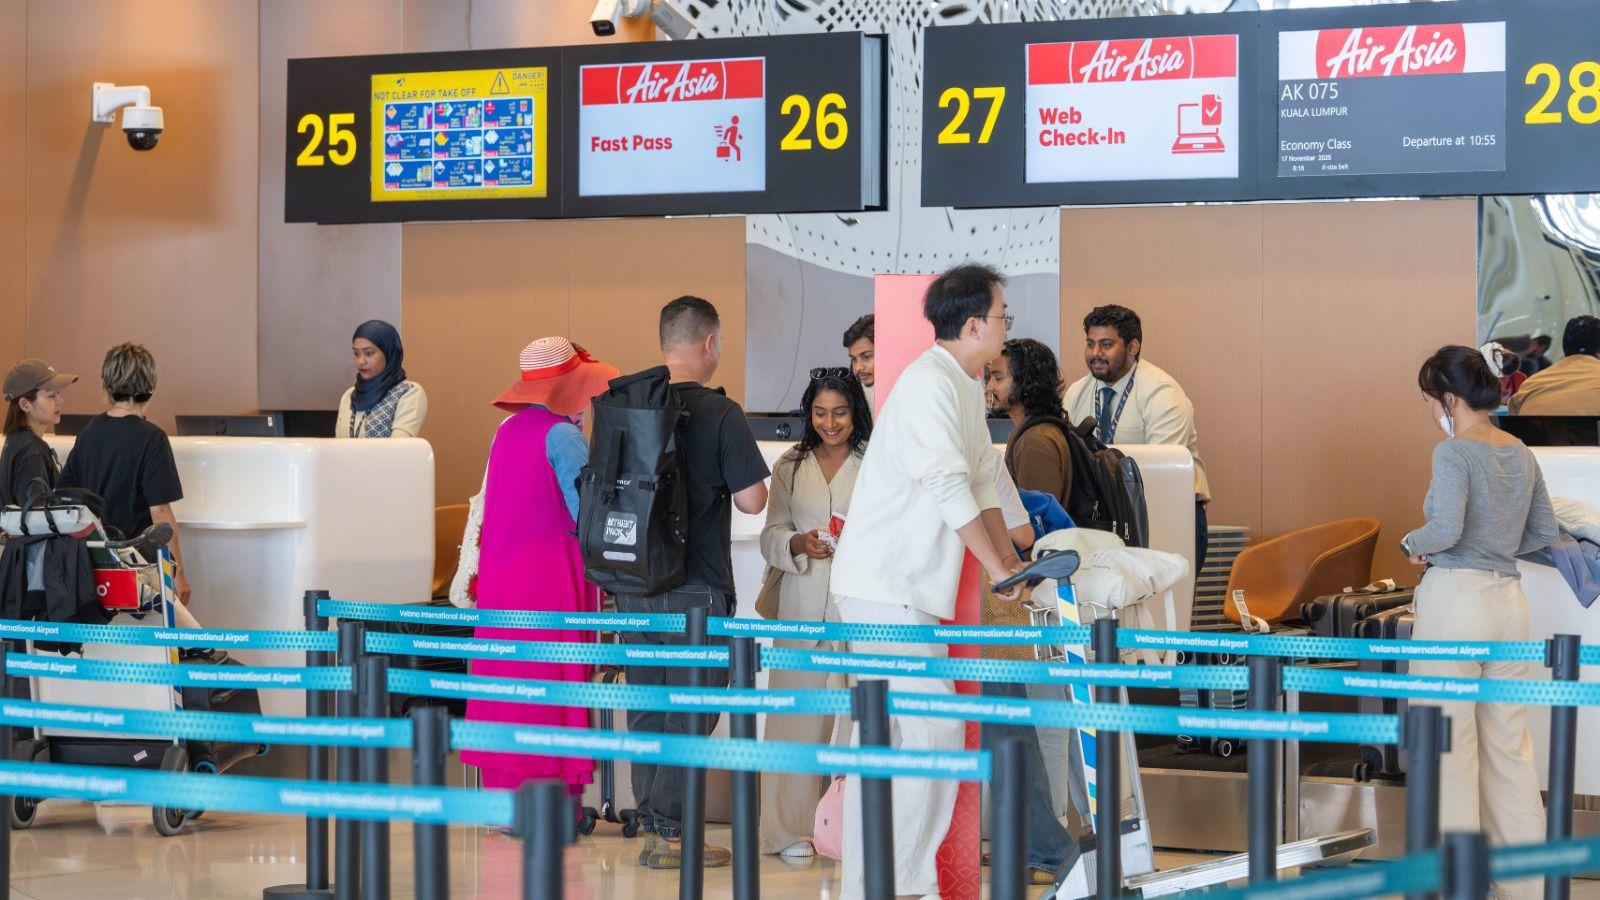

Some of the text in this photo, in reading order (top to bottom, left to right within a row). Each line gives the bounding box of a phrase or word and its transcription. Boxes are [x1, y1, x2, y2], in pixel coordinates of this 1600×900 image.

[374, 88, 476, 100] NOT CLEAR FOR TAKE OFF
[1281, 83, 1338, 100] AK 075
[1525, 61, 1600, 125] 28
[937, 86, 1005, 144] 27
[1039, 107, 1082, 124] Web
[1281, 106, 1348, 118] KUALA LUMPUR
[780, 93, 848, 150] 26
[297, 112, 357, 166] 25
[591, 134, 672, 152] Fast Pass
[1039, 128, 1125, 147] Check-In
[1403, 135, 1496, 149] Departure at 10:55
[1281, 138, 1351, 152] Economy Class
[400, 610, 479, 622] Velana International Airport
[564, 616, 649, 627] Velana International Airport
[36, 626, 59, 635] Airport
[724, 621, 825, 634] Velana International Airport
[934, 629, 1042, 639] Velana International Airport
[154, 632, 249, 644] Velana International Airport
[1135, 635, 1248, 650] Velana International Airport
[413, 640, 516, 654] Velana International Airport
[1369, 644, 1490, 657] Velana International Airport
[626, 648, 729, 662] Velana International Airpo
[811, 655, 926, 671] Velana International Airport
[188, 671, 301, 684] Velana International Airport
[1048, 667, 1172, 682] Velana International Airport
[430, 678, 546, 697] Velana International Airport
[1343, 676, 1479, 694] Velana International Airport
[669, 693, 794, 707] Velana International Airport
